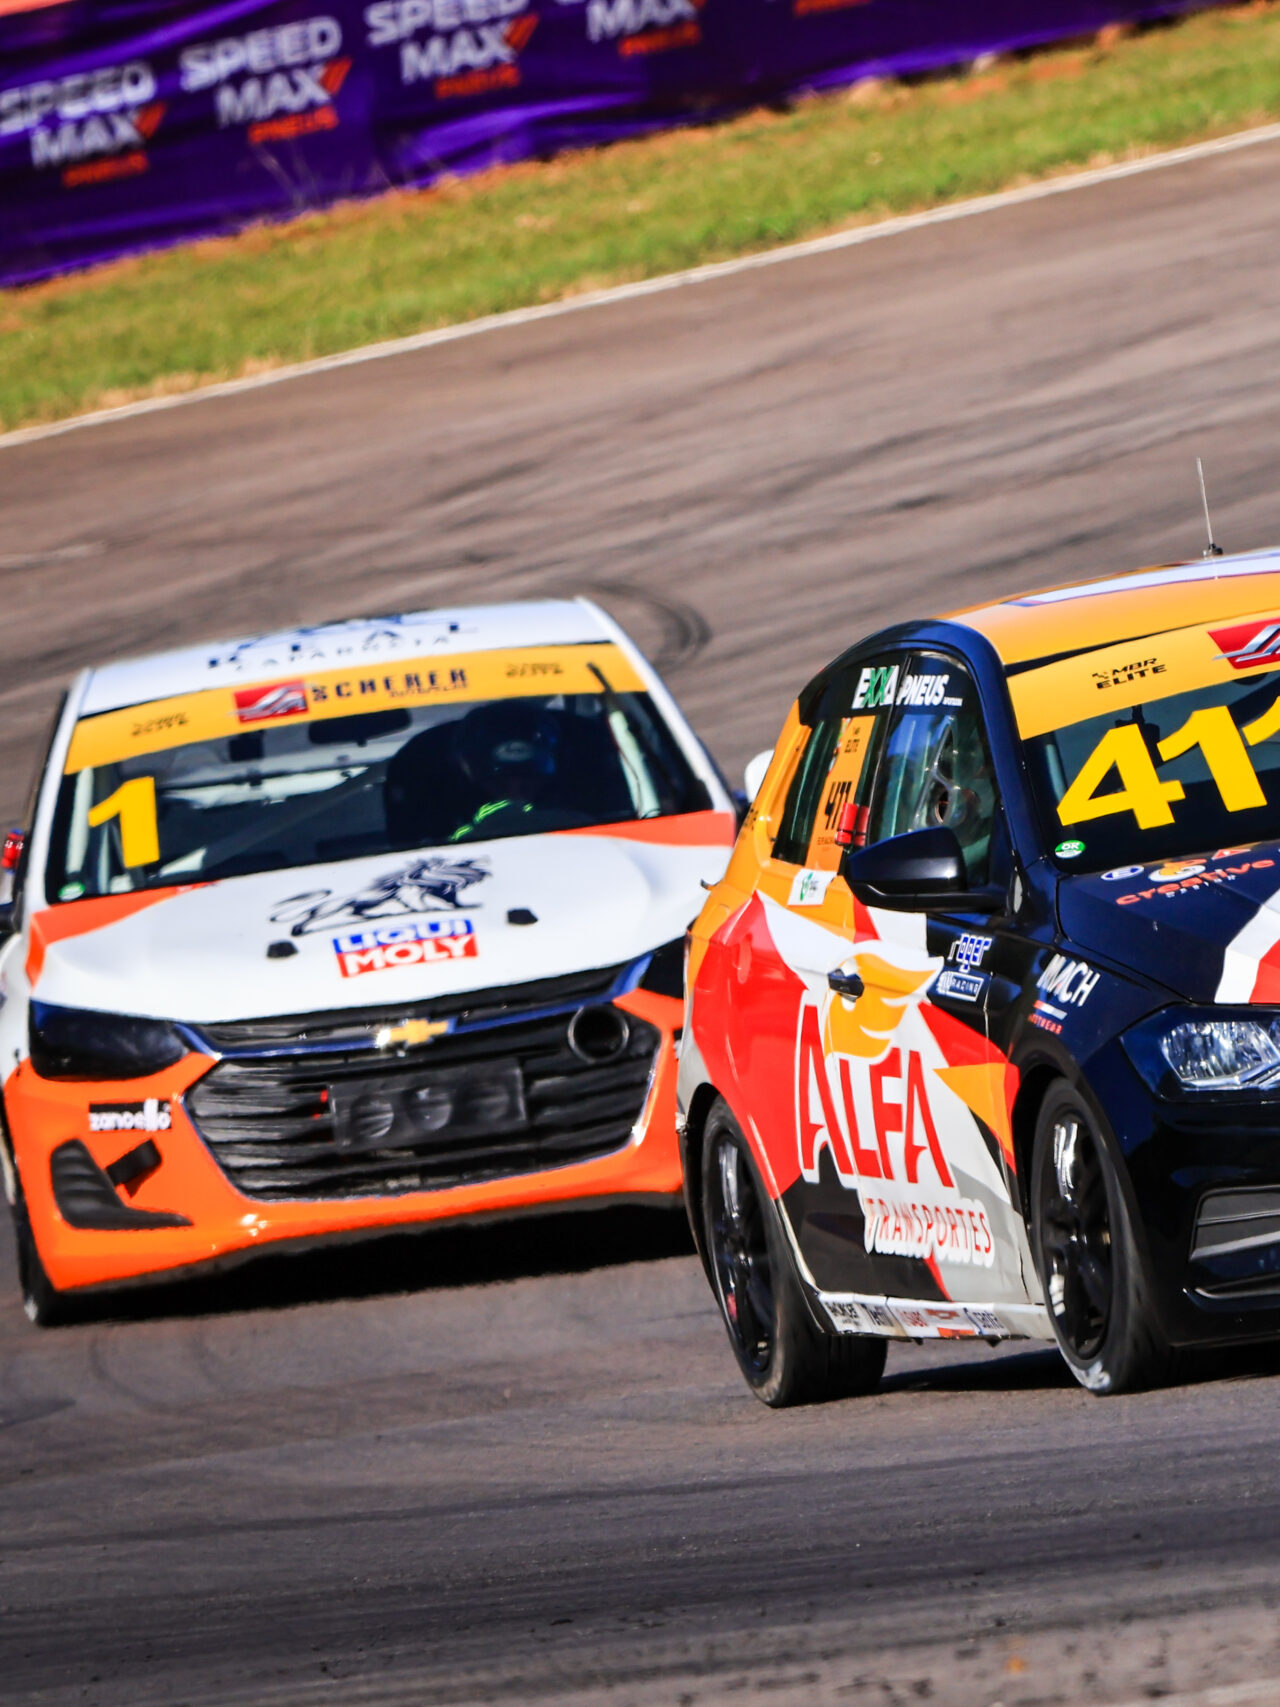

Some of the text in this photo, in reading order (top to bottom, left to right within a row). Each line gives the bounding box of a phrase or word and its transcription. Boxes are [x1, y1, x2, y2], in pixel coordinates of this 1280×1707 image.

[179, 16, 342, 91] SPEED
[401, 17, 517, 84] MAX
[0, 61, 156, 138] SPEED
[216, 64, 331, 128] MAX
[31, 110, 145, 170] MAX
[895, 675, 950, 706] PNEUS
[1096, 664, 1168, 690] ELITE
[88, 776, 160, 869] 1
[336, 920, 469, 953] LIQUI
[344, 935, 473, 975] MOLY
[800, 1003, 955, 1189] ALFA
[864, 1197, 993, 1256] TRANSPORTES
